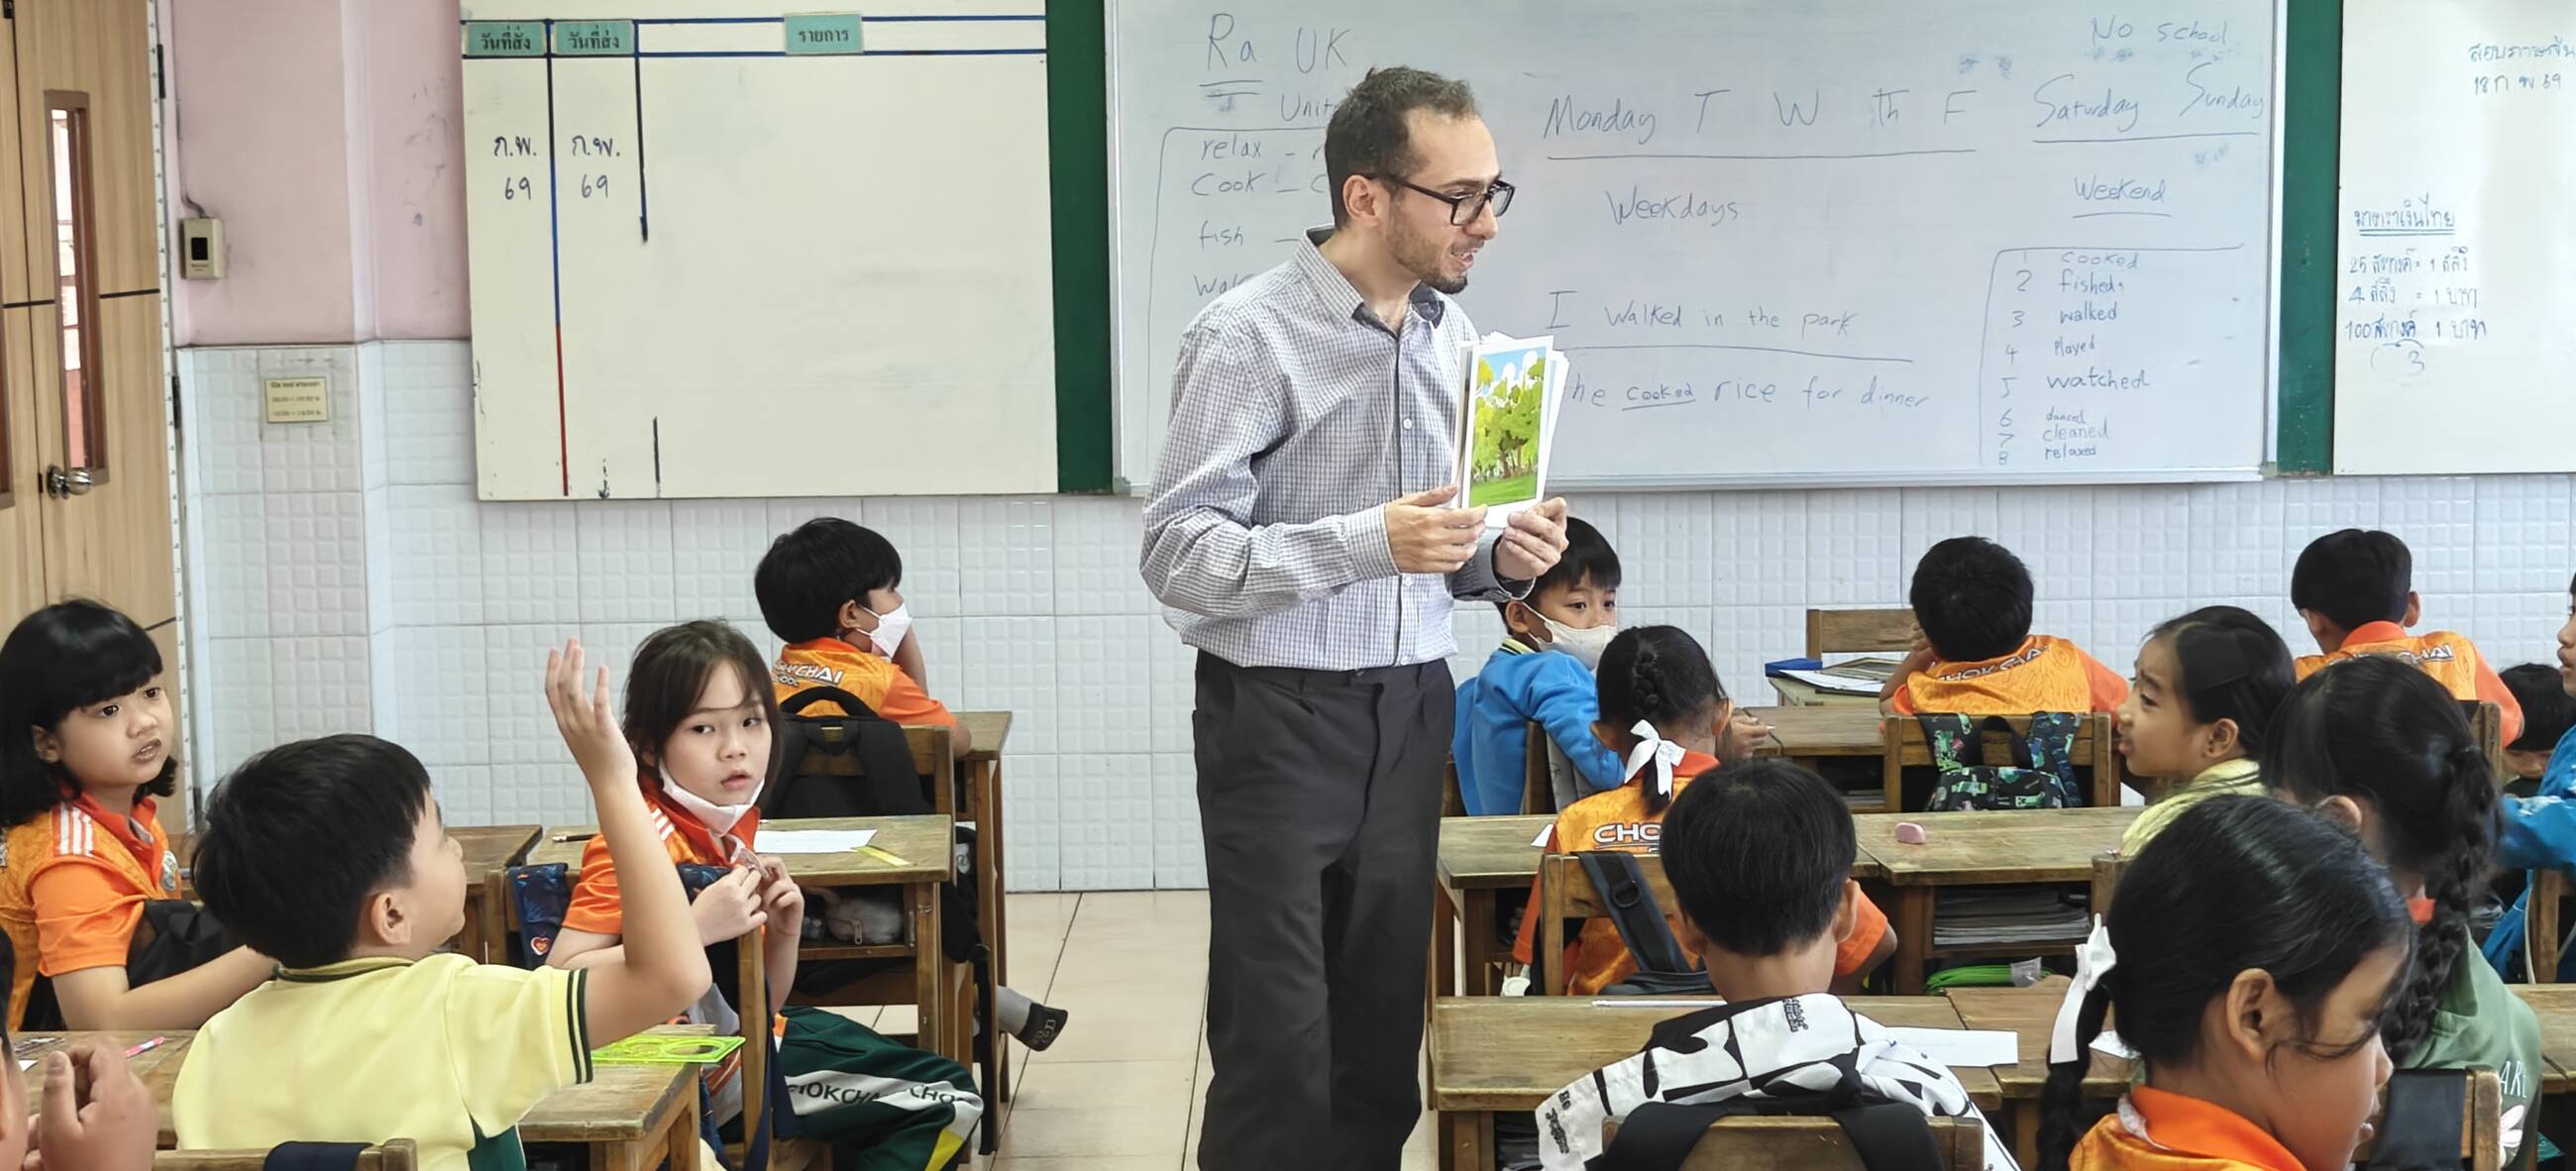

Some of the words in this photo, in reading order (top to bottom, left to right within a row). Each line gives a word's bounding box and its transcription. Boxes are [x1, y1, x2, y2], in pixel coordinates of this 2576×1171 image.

[798, 29, 849, 43] รายการ
[2090, 15, 2134, 45] No
[1295, 26, 1351, 75] UK
[2542, 72, 2561, 89] 69
[2033, 73, 2139, 134] Saturday
[2179, 61, 2264, 120] Sunday
[1543, 94, 1657, 146] Monday
[1693, 88, 1732, 133] T
[1772, 89, 1820, 127] W
[1943, 89, 1978, 125] F
[493, 135, 537, 158] ก.พ.
[571, 135, 621, 158] ก.พ.
[1201, 134, 1261, 161] relax
[504, 176, 532, 201] 69
[581, 173, 608, 199] 69
[2074, 174, 2166, 202] Weekend
[1605, 184, 1739, 228] Weekdays
[1198, 220, 1244, 249] fish
[2349, 256, 2367, 273] 25
[2015, 268, 2033, 292] 2
[2348, 284, 2366, 304] 4
[1545, 289, 1578, 330] I
[1703, 309, 1725, 327] in
[1749, 305, 1779, 328] the
[1801, 310, 1859, 338] park
[2011, 310, 2025, 329] 3
[2060, 300, 2117, 325] walked
[2004, 344, 2018, 364] 4
[1626, 383, 1697, 402] cooked
[1713, 377, 1777, 404] rice
[1801, 374, 1843, 409] for
[1860, 374, 1930, 408] dinner
[2000, 375, 2018, 399] 5
[2046, 366, 2150, 390] watched
[1998, 407, 2013, 428] 6
[1996, 432, 2015, 449] 7
[2042, 417, 2109, 442] cleaned
[1997, 451, 2009, 466] 8
[2044, 443, 2096, 461] relaxed
